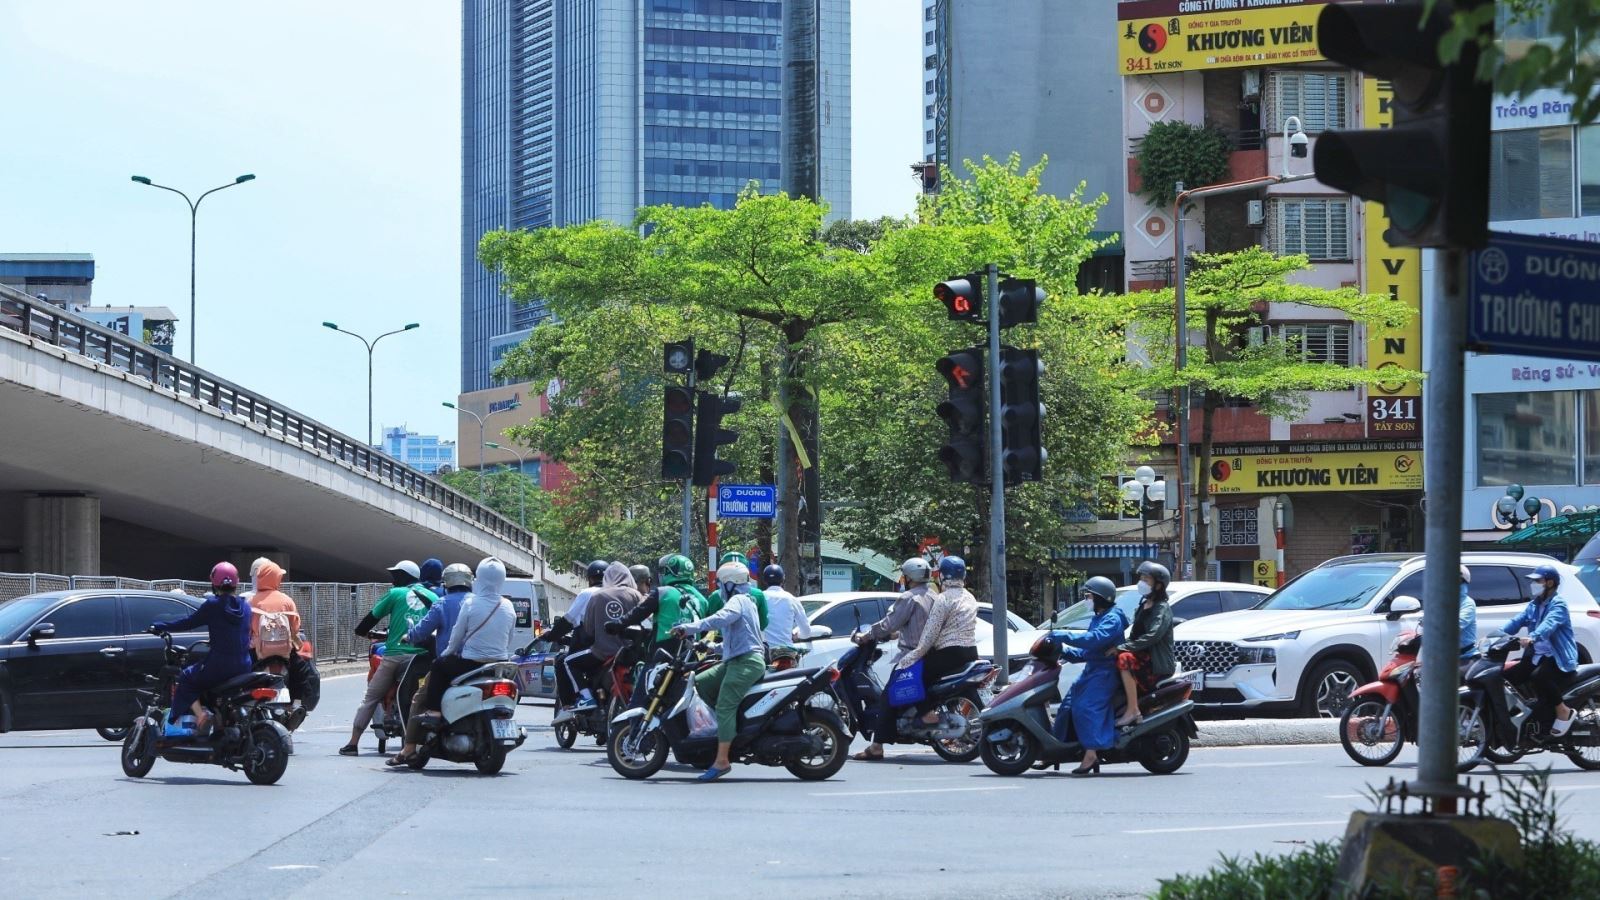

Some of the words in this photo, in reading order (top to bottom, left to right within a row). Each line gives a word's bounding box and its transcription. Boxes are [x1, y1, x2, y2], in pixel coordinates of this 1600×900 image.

[1187, 31, 1265, 51] KHƯƠNG
[1270, 21, 1314, 46] VIÊN
[1126, 56, 1153, 72] 341
[1153, 60, 1167, 70] TÂY
[1168, 60, 1182, 69] SƠN
[1495, 99, 1537, 119] Trồng
[1542, 101, 1572, 114] Răn
[1526, 253, 1600, 281] ĐƯỜN
[1381, 259, 1406, 354] VIN
[1511, 366, 1552, 382] Răng
[1556, 363, 1575, 379] Sứ
[1372, 399, 1417, 420] 341
[1374, 421, 1393, 431] TÂY
[1395, 421, 1416, 431] SƠN
[1257, 457, 1272, 465] ĐÔNG
[1257, 467, 1331, 487] KHƯƠNG
[1337, 462, 1379, 486] VIÊN
[1208, 484, 1219, 493] 41
[750, 501, 772, 513] CHINH
